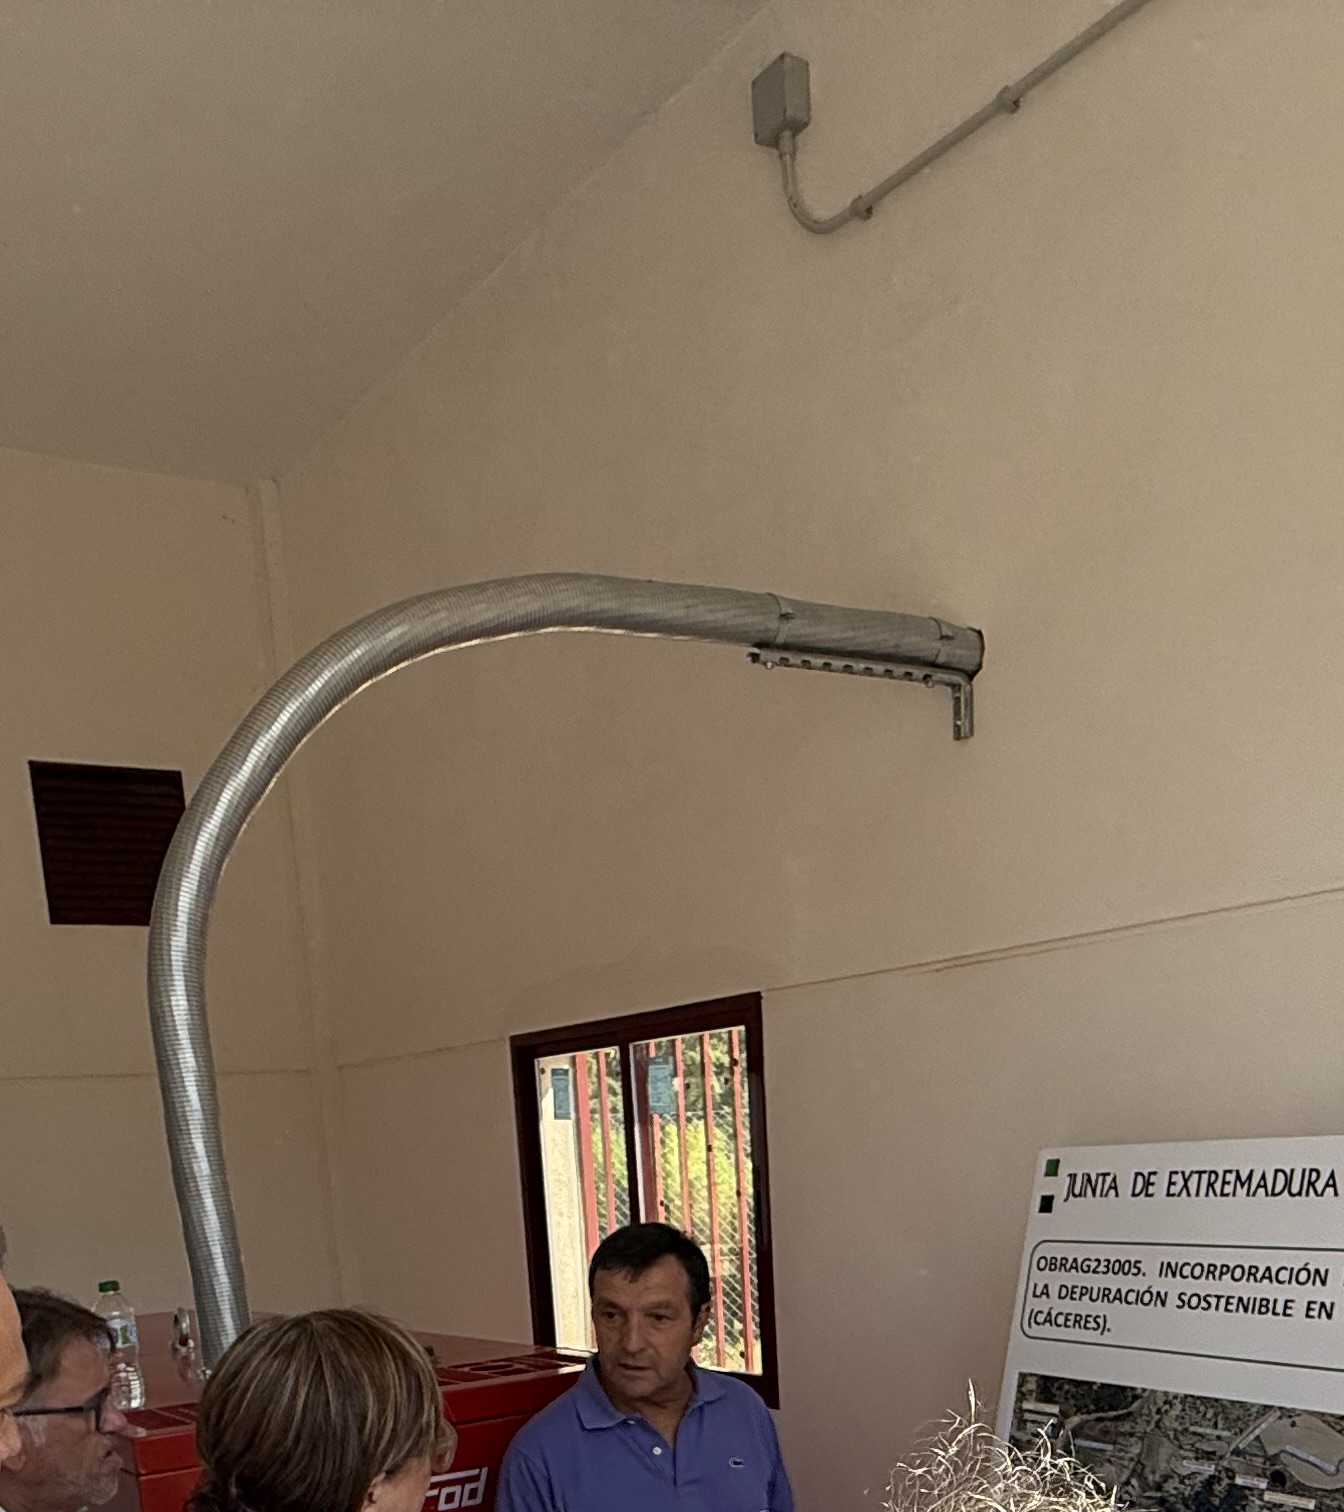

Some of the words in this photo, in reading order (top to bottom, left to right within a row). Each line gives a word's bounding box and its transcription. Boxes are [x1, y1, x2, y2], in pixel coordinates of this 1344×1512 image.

[1063, 1171, 1120, 1203] JUNTA
[1130, 1170, 1159, 1198] DE
[1165, 1167, 1340, 1198] EXTREMADURA
[1036, 1255, 1146, 1278] OBRAG23005.
[1158, 1260, 1330, 1287] INCORPORACIÓN
[1031, 1282, 1051, 1300] LA
[1057, 1283, 1169, 1308] DEPURACIÓN
[1175, 1291, 1296, 1318] SOSTENIBLE
[1304, 1300, 1336, 1321] EN
[1027, 1306, 1112, 1337] (CÁCERES).
